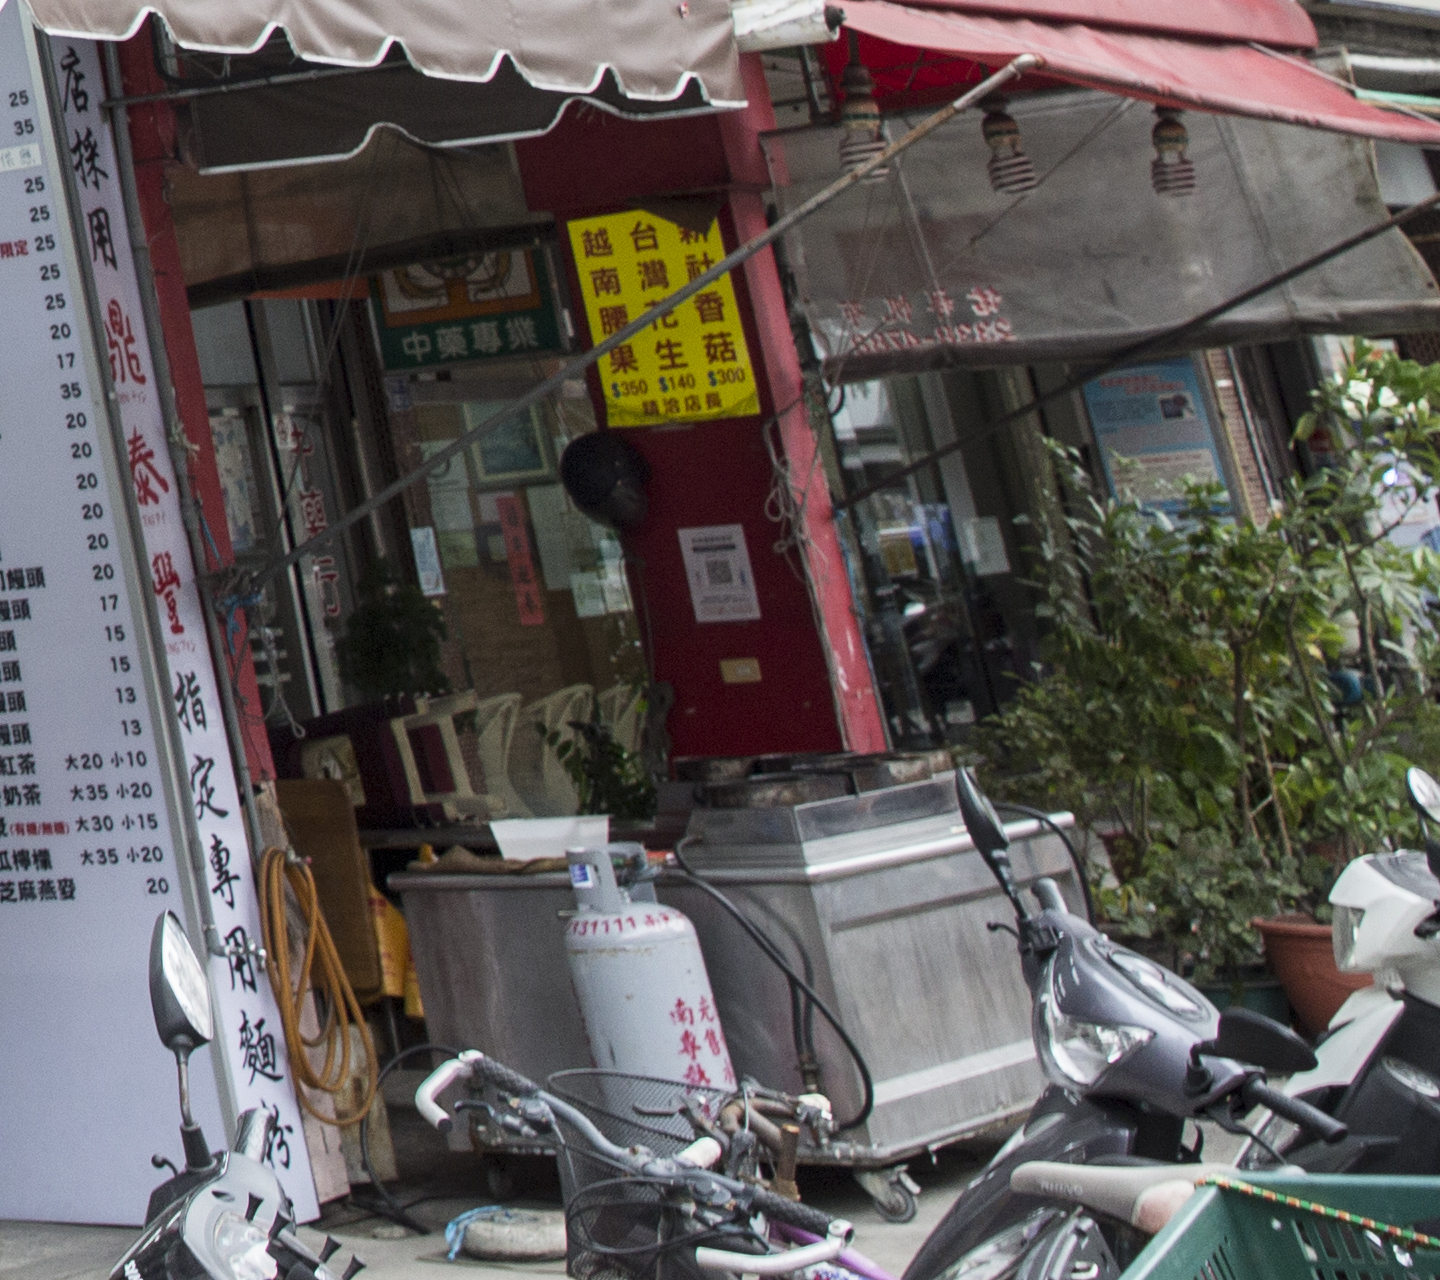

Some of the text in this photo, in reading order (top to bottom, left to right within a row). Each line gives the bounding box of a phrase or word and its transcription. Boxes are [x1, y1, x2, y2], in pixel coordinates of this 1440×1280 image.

[9, 91, 29, 107] 25
[14, 119, 34, 136] 35
[24, 177, 44, 193] 25
[29, 206, 50, 222] 25
[35, 235, 55, 251] 25
[40, 264, 60, 281] 25
[45, 294, 66, 310] 25
[583, 227, 638, 374] 越南腰果
[50, 323, 71, 339] 20
[57, 353, 76, 369] 17
[658, 373, 696, 393] $140
[707, 367, 745, 387] $300
[60, 382, 82, 399] 35
[611, 380, 649, 399] $350
[66, 412, 87, 429] 20
[71, 442, 92, 459] 20
[76, 472, 98, 490] 20
[82, 503, 103, 520] 20
[87, 533, 108, 550] 20
[93, 564, 114, 581] 20
[100, 595, 119, 611] 17
[105, 625, 125, 641] 15
[110, 656, 130, 672] 15
[116, 687, 136, 703] 13
[121, 719, 142, 736] 13
[147, 877, 169, 894] 20
